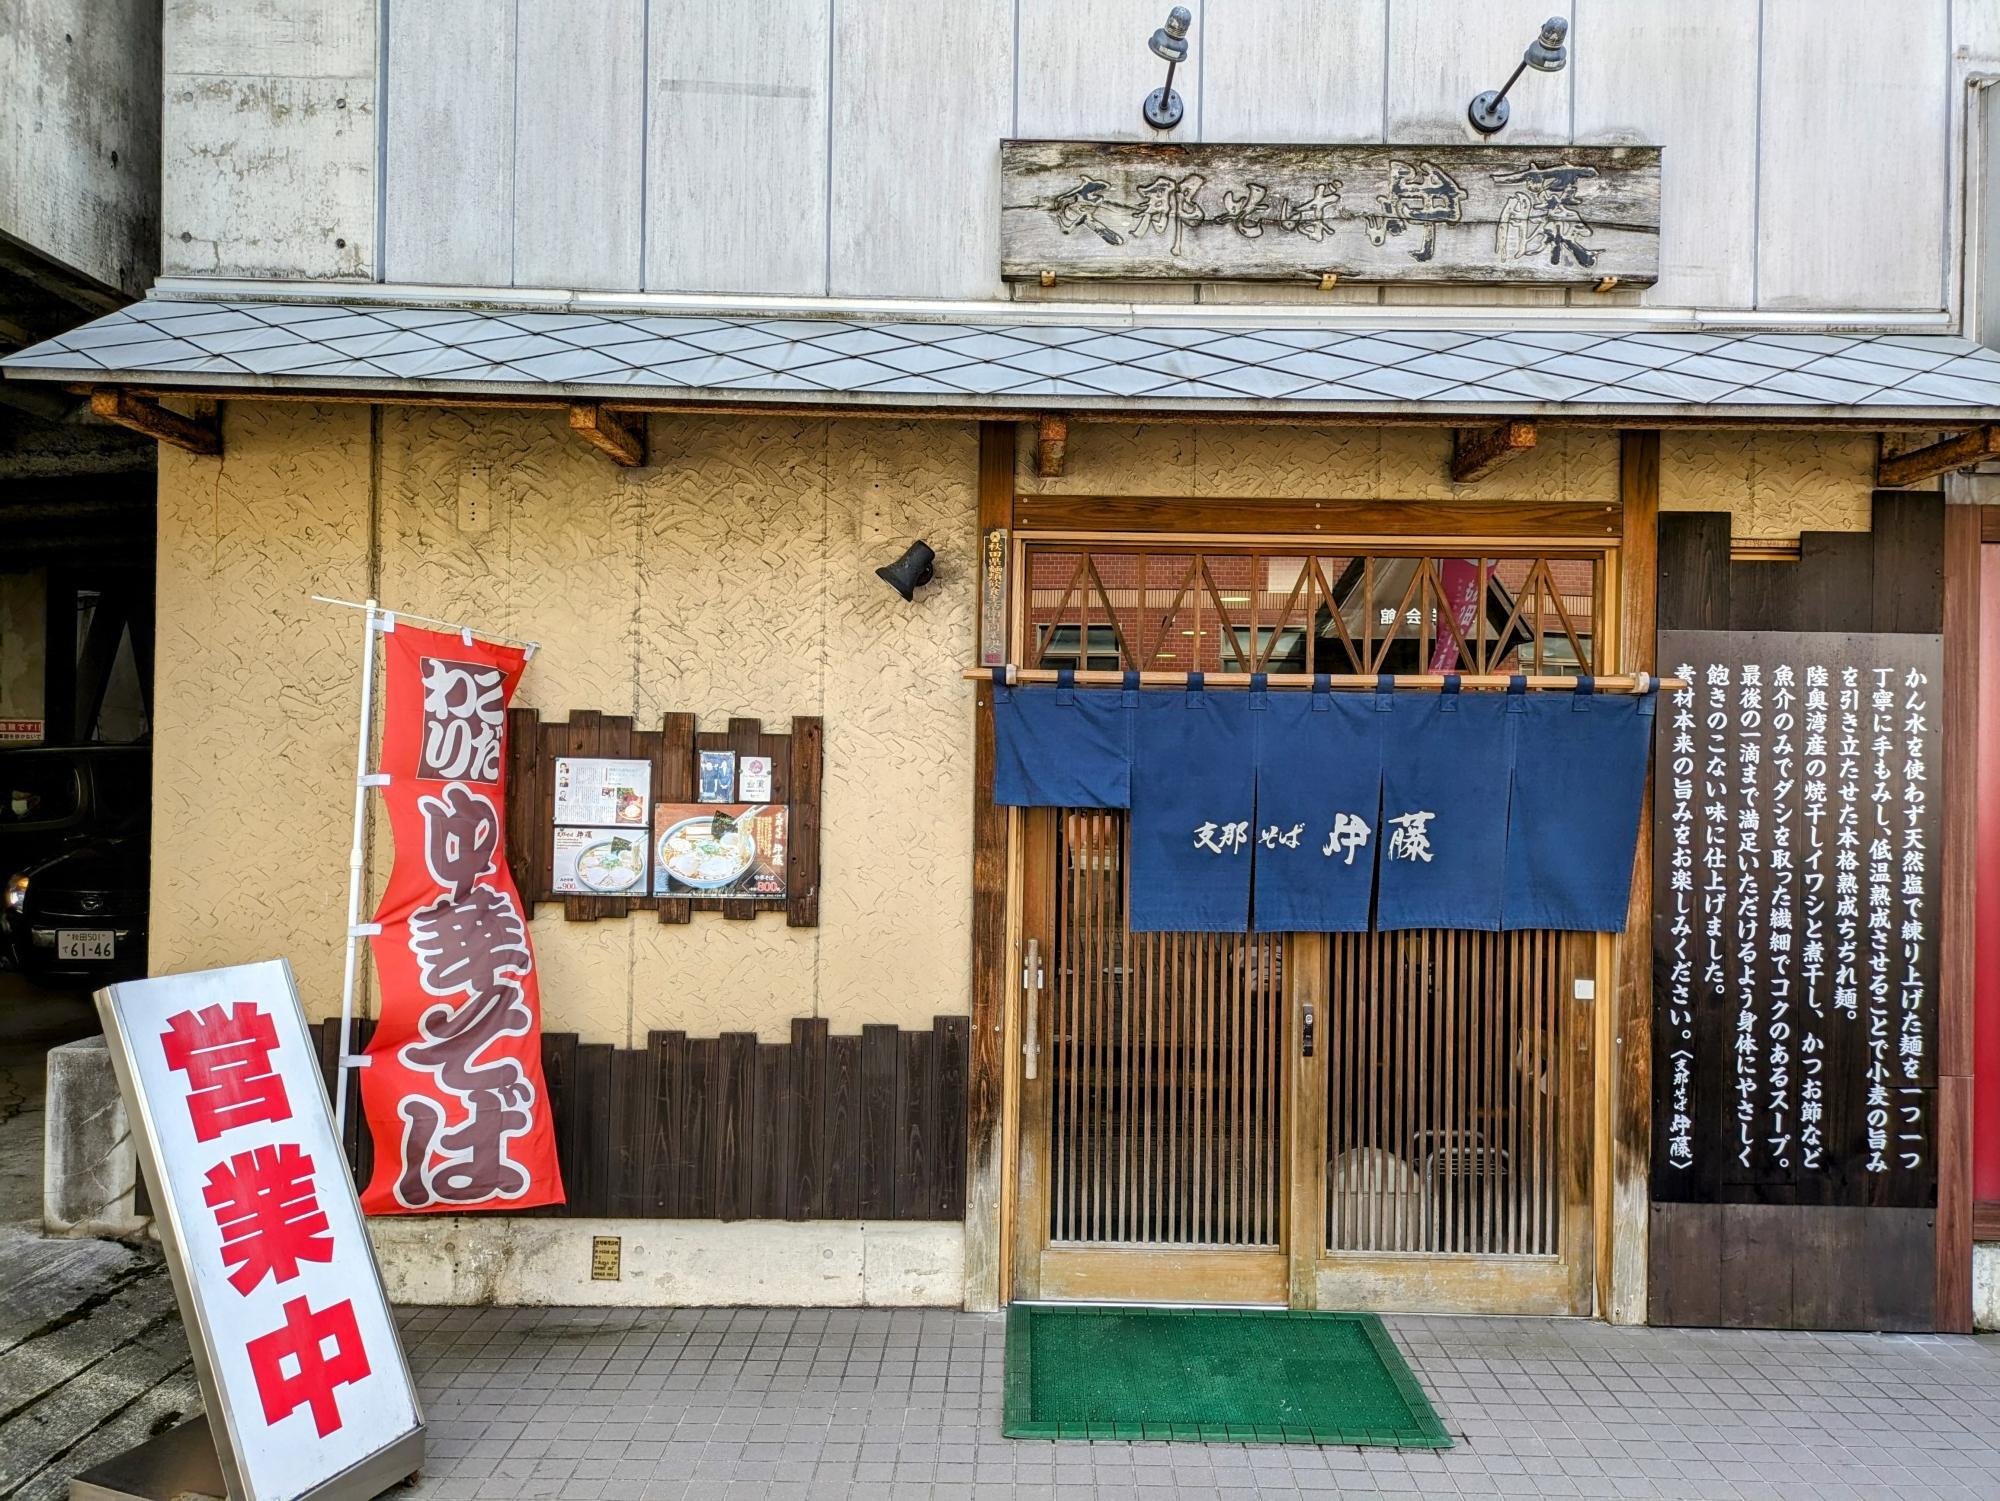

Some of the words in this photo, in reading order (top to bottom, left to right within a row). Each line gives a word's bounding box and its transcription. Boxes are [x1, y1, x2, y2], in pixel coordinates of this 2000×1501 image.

[71, 942, 111, 957] 61-46
[397, 781, 534, 1211] 中華そば
[1702, 664, 1730, 995] 飽きのこない味に仕上げました。
[1734, 664, 1763, 1169] 最後の一滴まで満足いただけるよう身体にやさしく
[1767, 664, 1796, 1169] 魚介のみでダシを取った繊細でコクのあるスープ。
[1833, 665, 1861, 1021] を引き立たせた本格熟成ちぢれ麺。
[1865, 667, 1896, 1174] 丁寧に手もみし、低温熟成させることで小麦の旨み
[1898, 666, 1928, 1170] かん水を使わず天然塩で練り上げた麺を一つ一つ
[160, 1001, 372, 1439] 営業中
